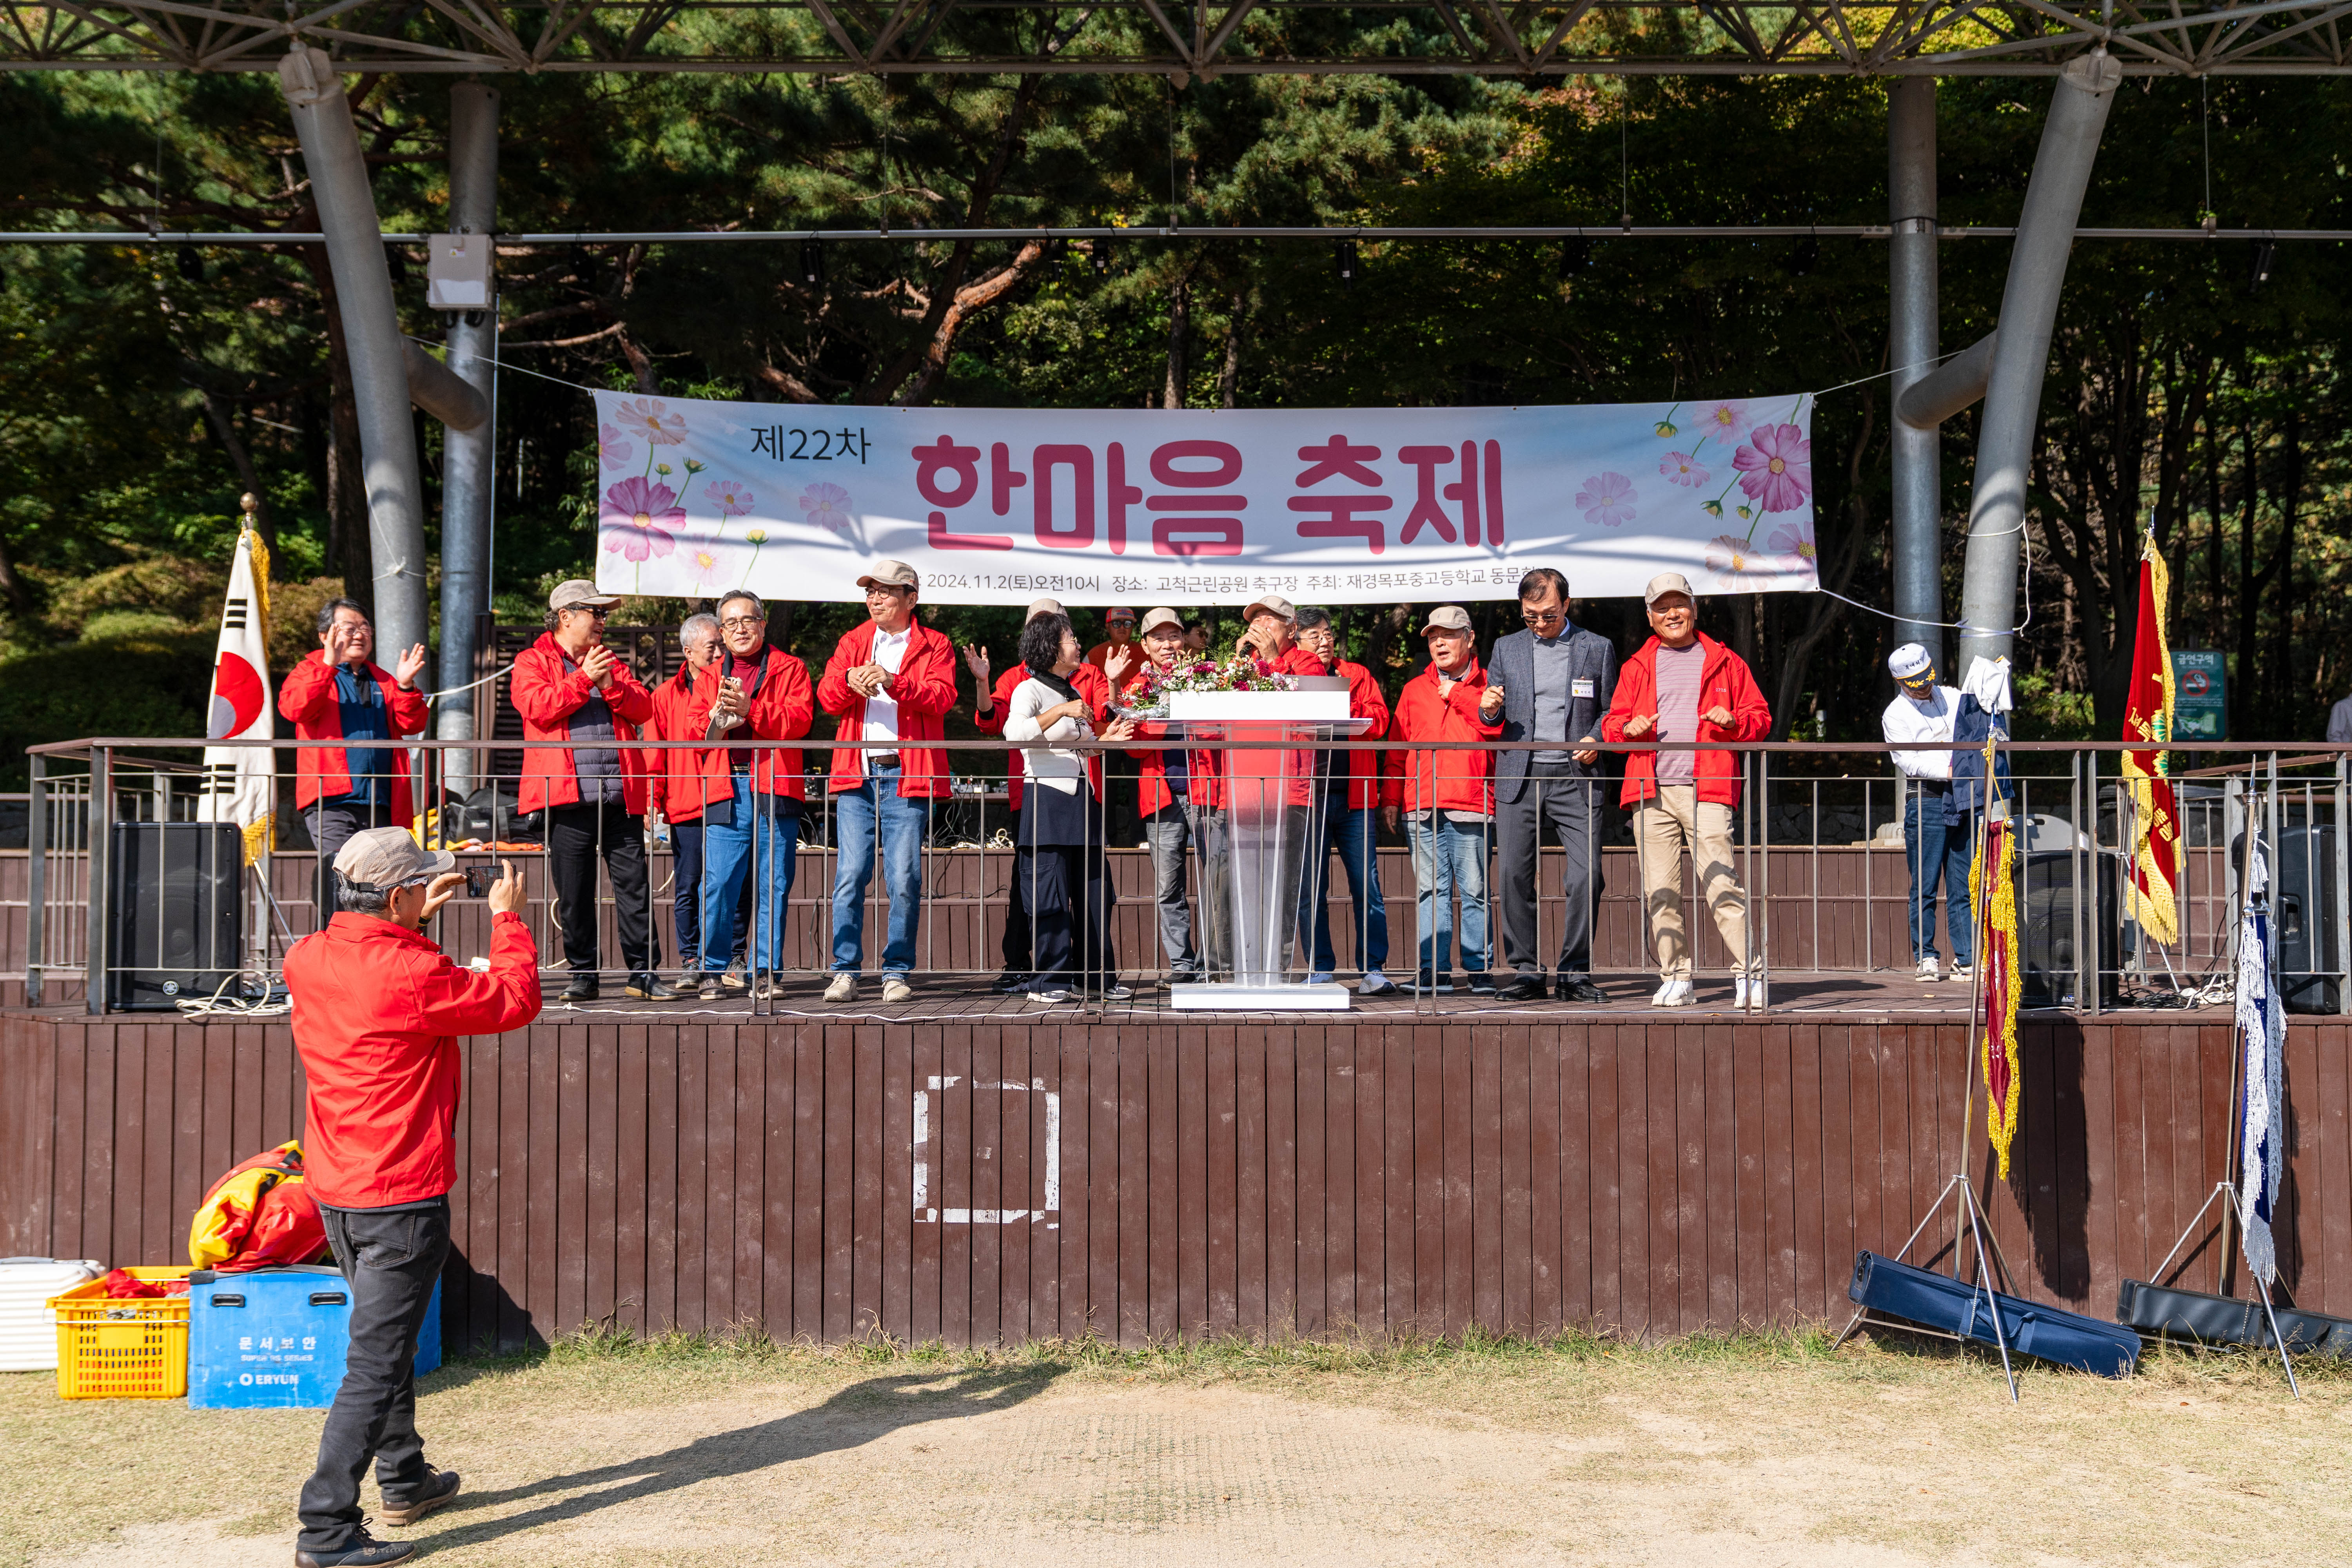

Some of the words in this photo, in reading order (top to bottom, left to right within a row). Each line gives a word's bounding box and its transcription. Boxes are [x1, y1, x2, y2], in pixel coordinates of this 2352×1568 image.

[750, 425, 871, 465] 제22차
[911, 434, 1248, 556] 한마음
[1287, 434, 1504, 555] 축제
[927, 574, 1099, 592] 2024.11.2(토)오전10시
[1112, 575, 1147, 593] 장소:
[1156, 575, 1248, 593] 고척근린공원
[1252, 576, 1299, 592] 축구장
[1306, 575, 1341, 590] 주최:
[1347, 569, 1487, 589] 재경목포중고등학교
[2177, 653, 2214, 665] 금연구역
[255, 1374, 299, 1385] ERYUN
